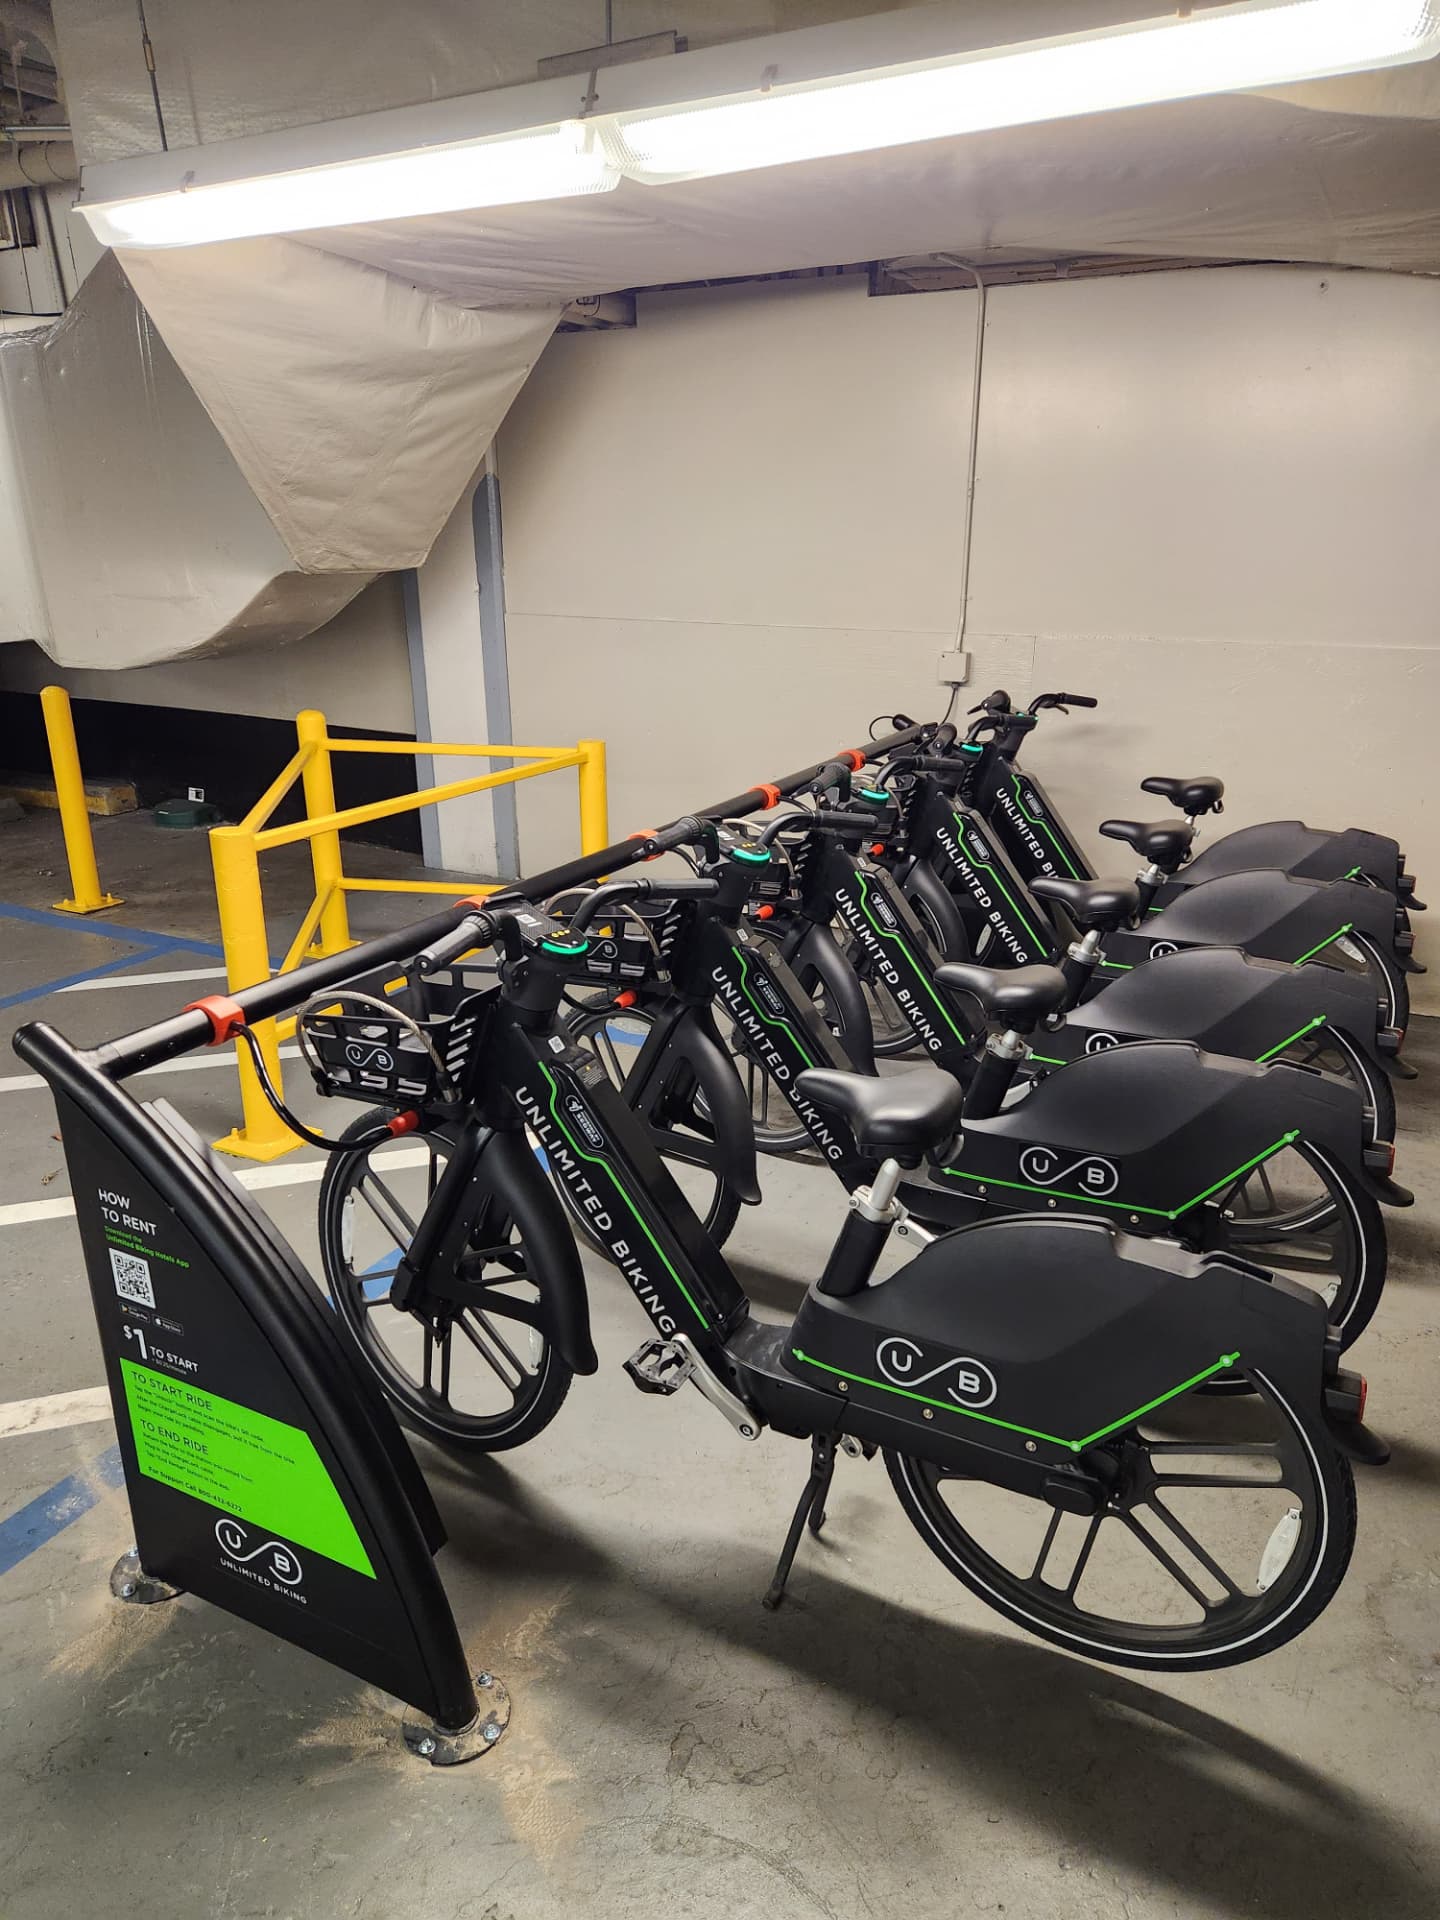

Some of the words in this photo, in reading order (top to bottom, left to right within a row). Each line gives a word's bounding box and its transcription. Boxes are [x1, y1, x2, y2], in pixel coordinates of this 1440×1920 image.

[996, 787, 1045, 860] UNLIMITED
[936, 827, 992, 908] UNLIMITED
[989, 911, 1028, 963] BIKING
[835, 888, 899, 984] UNLIMITED
[897, 989, 943, 1051] BIKING
[711, 966, 790, 1080] UNLIMITED
[98, 1187, 130, 1210] HOW
[100, 1206, 119, 1223] TO
[122, 1213, 157, 1236] RENT
[515, 1086, 612, 1231] UNLIMITED
[611, 1240, 676, 1333] BIKING
[149, 1345, 164, 1359] TO
[166, 1352, 199, 1373] START
[131, 1370, 147, 1385] TO
[149, 1377, 183, 1399] START
[186, 1392, 214, 1412] RIDE
[140, 1418, 155, 1433] TO
[158, 1424, 181, 1443] END
[183, 1436, 209, 1456] RIDE
[220, 1557, 271, 1586] UNLIMITED
[273, 1583, 307, 1605] BIKING
